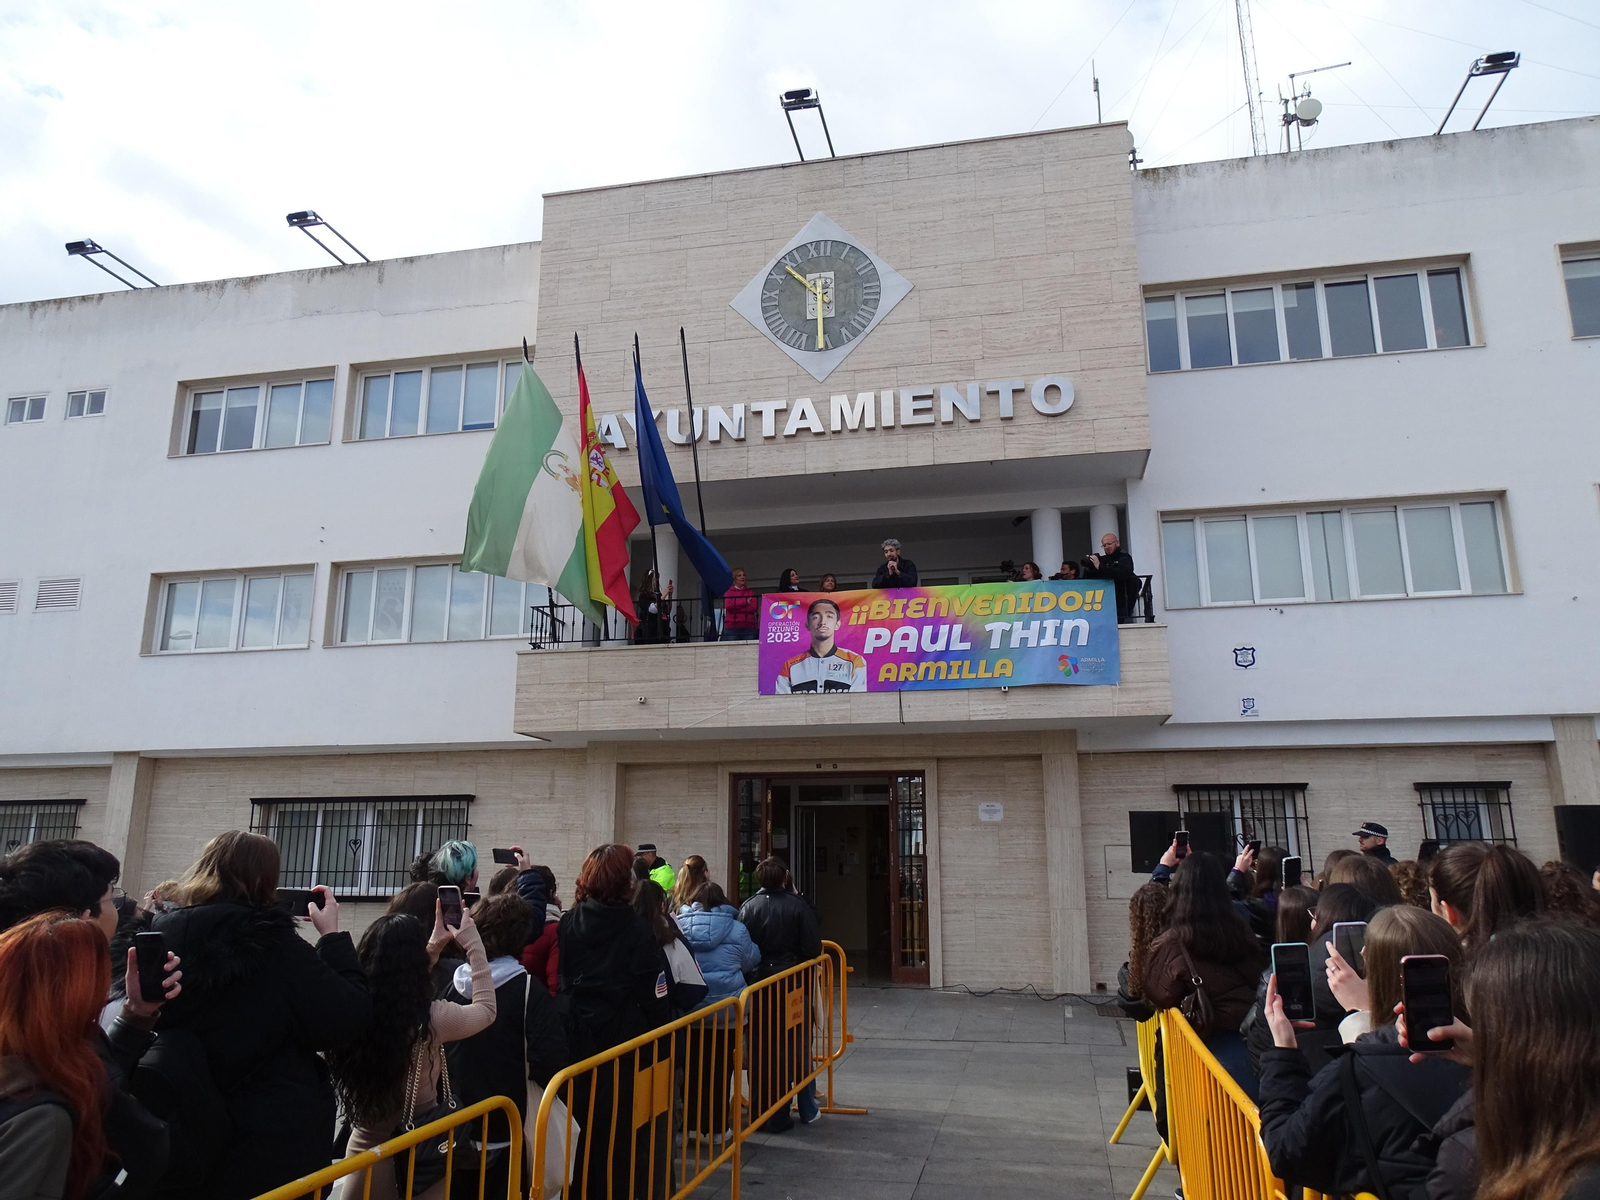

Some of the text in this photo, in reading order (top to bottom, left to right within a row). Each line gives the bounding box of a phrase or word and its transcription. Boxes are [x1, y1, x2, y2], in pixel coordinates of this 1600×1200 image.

[780, 249, 804, 268] XI
[806, 240, 833, 259] XII
[840, 245, 852, 260] I
[855, 260, 875, 276] II
[767, 272, 788, 285] X
[762, 289, 779, 307] IX
[862, 280, 881, 300] III
[764, 310, 789, 338] VIII
[850, 303, 876, 332] IIII
[786, 327, 809, 351] VII
[840, 326, 855, 343] V
[769, 600, 801, 619] OT
[767, 632, 800, 643] 2023
[863, 618, 1090, 653] PAUL THIN
[877, 658, 1014, 682] ARMILLA
